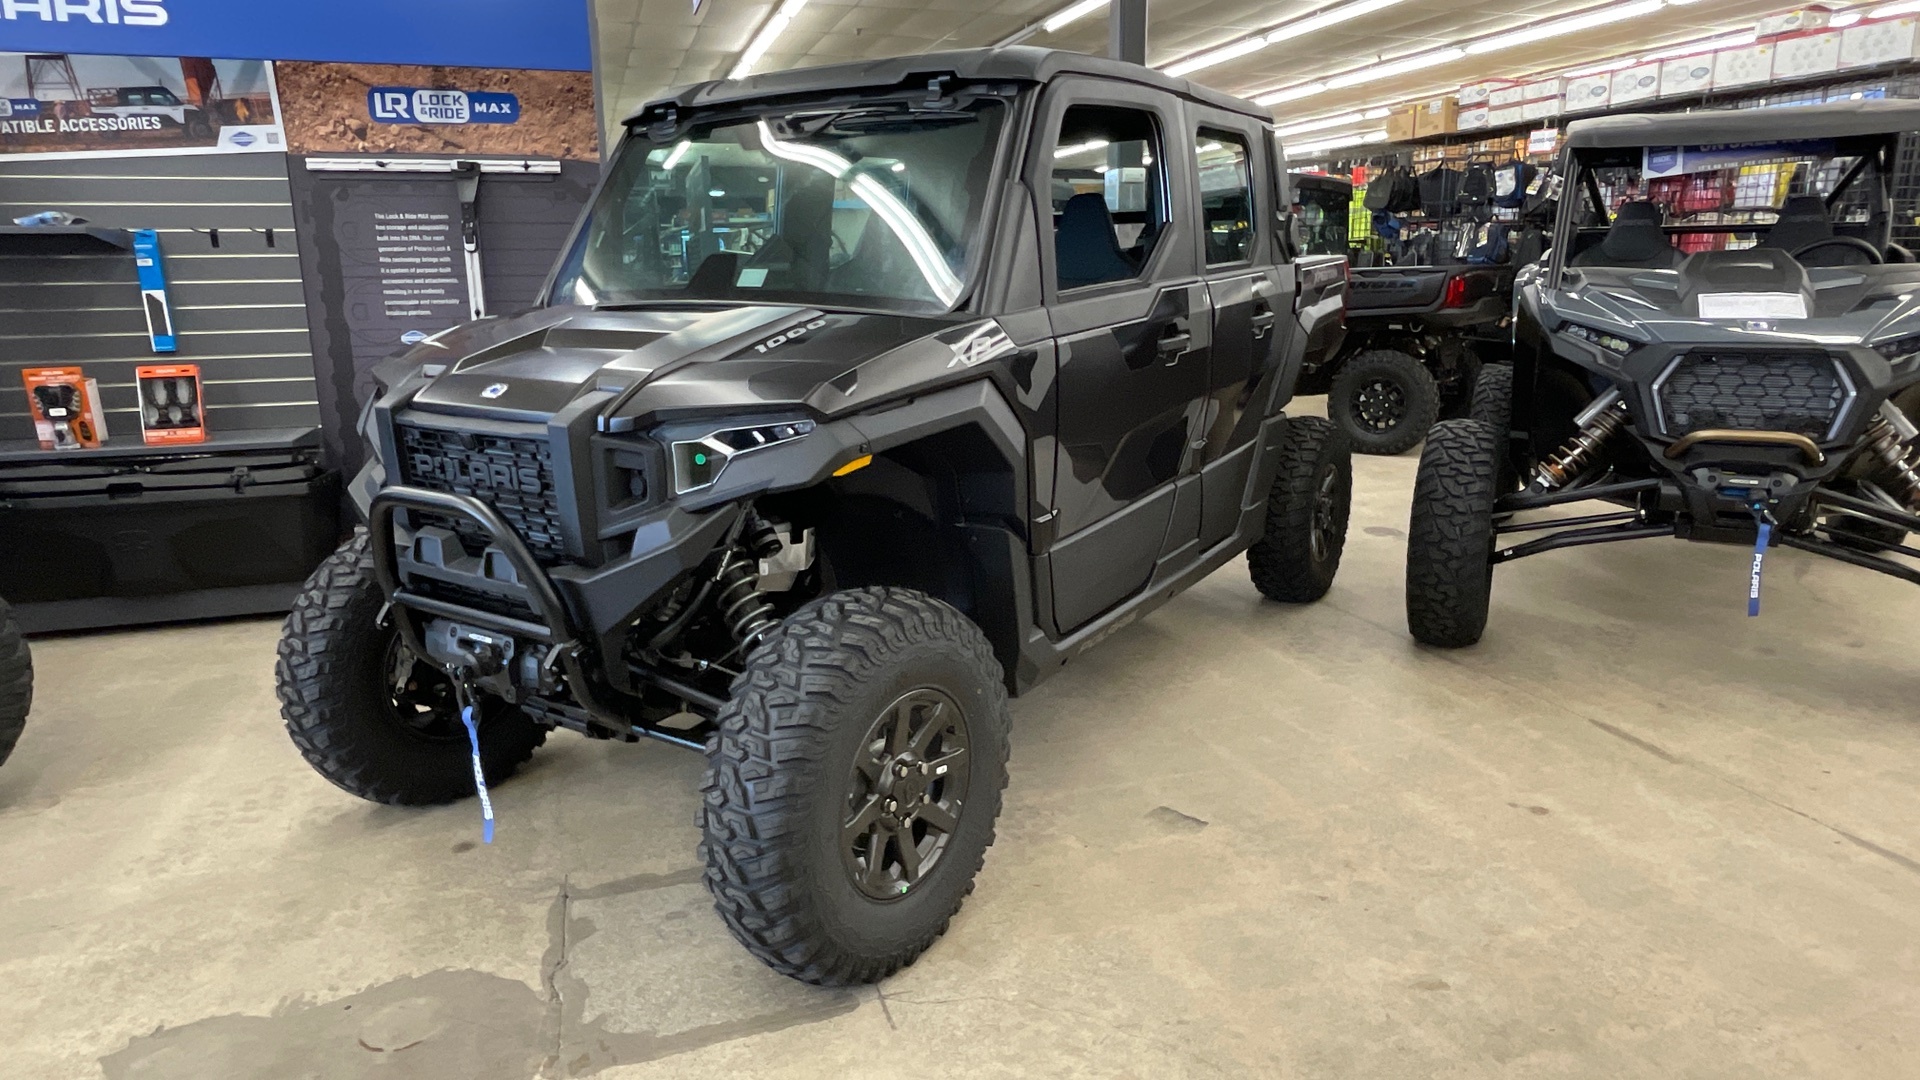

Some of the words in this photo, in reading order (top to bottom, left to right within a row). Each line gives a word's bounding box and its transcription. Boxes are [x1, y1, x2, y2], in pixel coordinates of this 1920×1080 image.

[0, 0, 168, 26] ARIS
[373, 92, 411, 118] LR
[419, 93, 463, 106] LOCK
[474, 102, 512, 114] MAX
[0, 118, 56, 134] ATIBLE
[59, 116, 162, 132] ACCESSORIES
[754, 319, 827, 354] 1000
[414, 453, 542, 494] POLARIS
[1750, 553, 1763, 599] POLARIS
